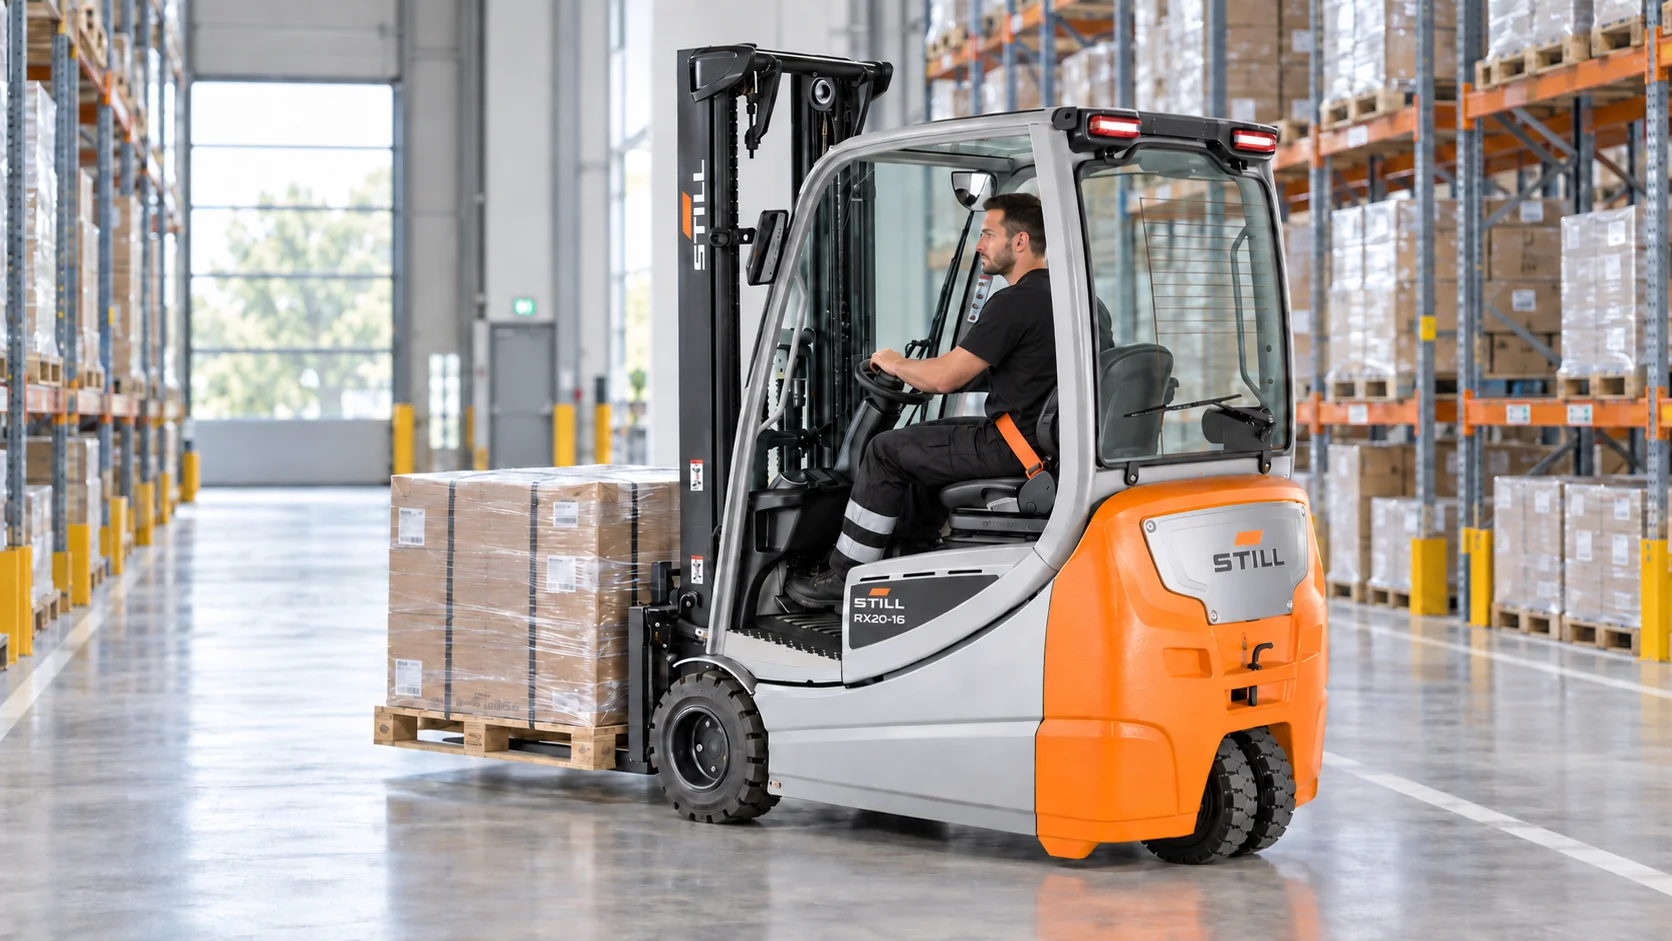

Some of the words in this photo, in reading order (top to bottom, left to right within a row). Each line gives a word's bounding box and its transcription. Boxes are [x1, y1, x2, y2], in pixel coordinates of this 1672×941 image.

[692, 159, 705, 271] STILL
[1212, 548, 1285, 573] STILL
[853, 597, 905, 609] STILL
[853, 613, 906, 625] RX20-16
